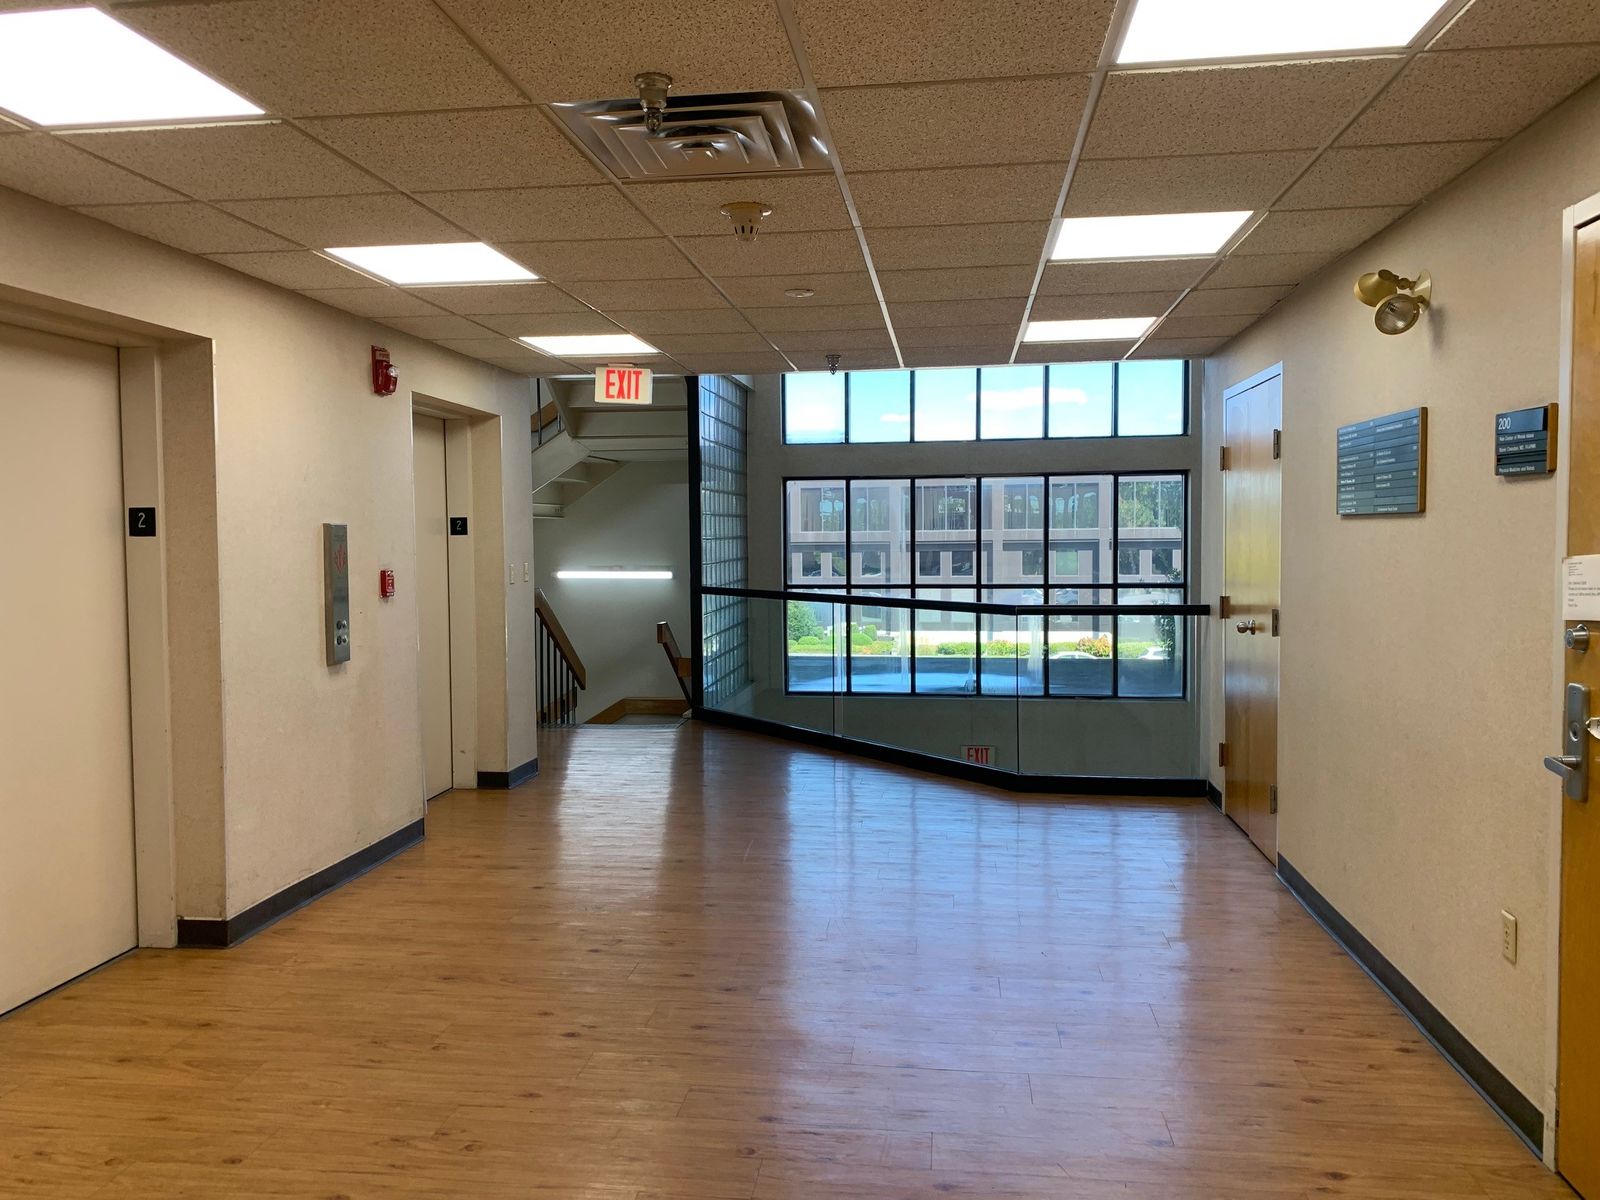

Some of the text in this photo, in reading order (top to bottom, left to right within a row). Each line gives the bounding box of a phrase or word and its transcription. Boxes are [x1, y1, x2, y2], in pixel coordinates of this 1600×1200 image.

[605, 369, 642, 400] EXIT
[1498, 417, 1511, 430] 200
[138, 512, 146, 528] 2
[456, 520, 462, 530] 2
[967, 747, 990, 764] EXIT
